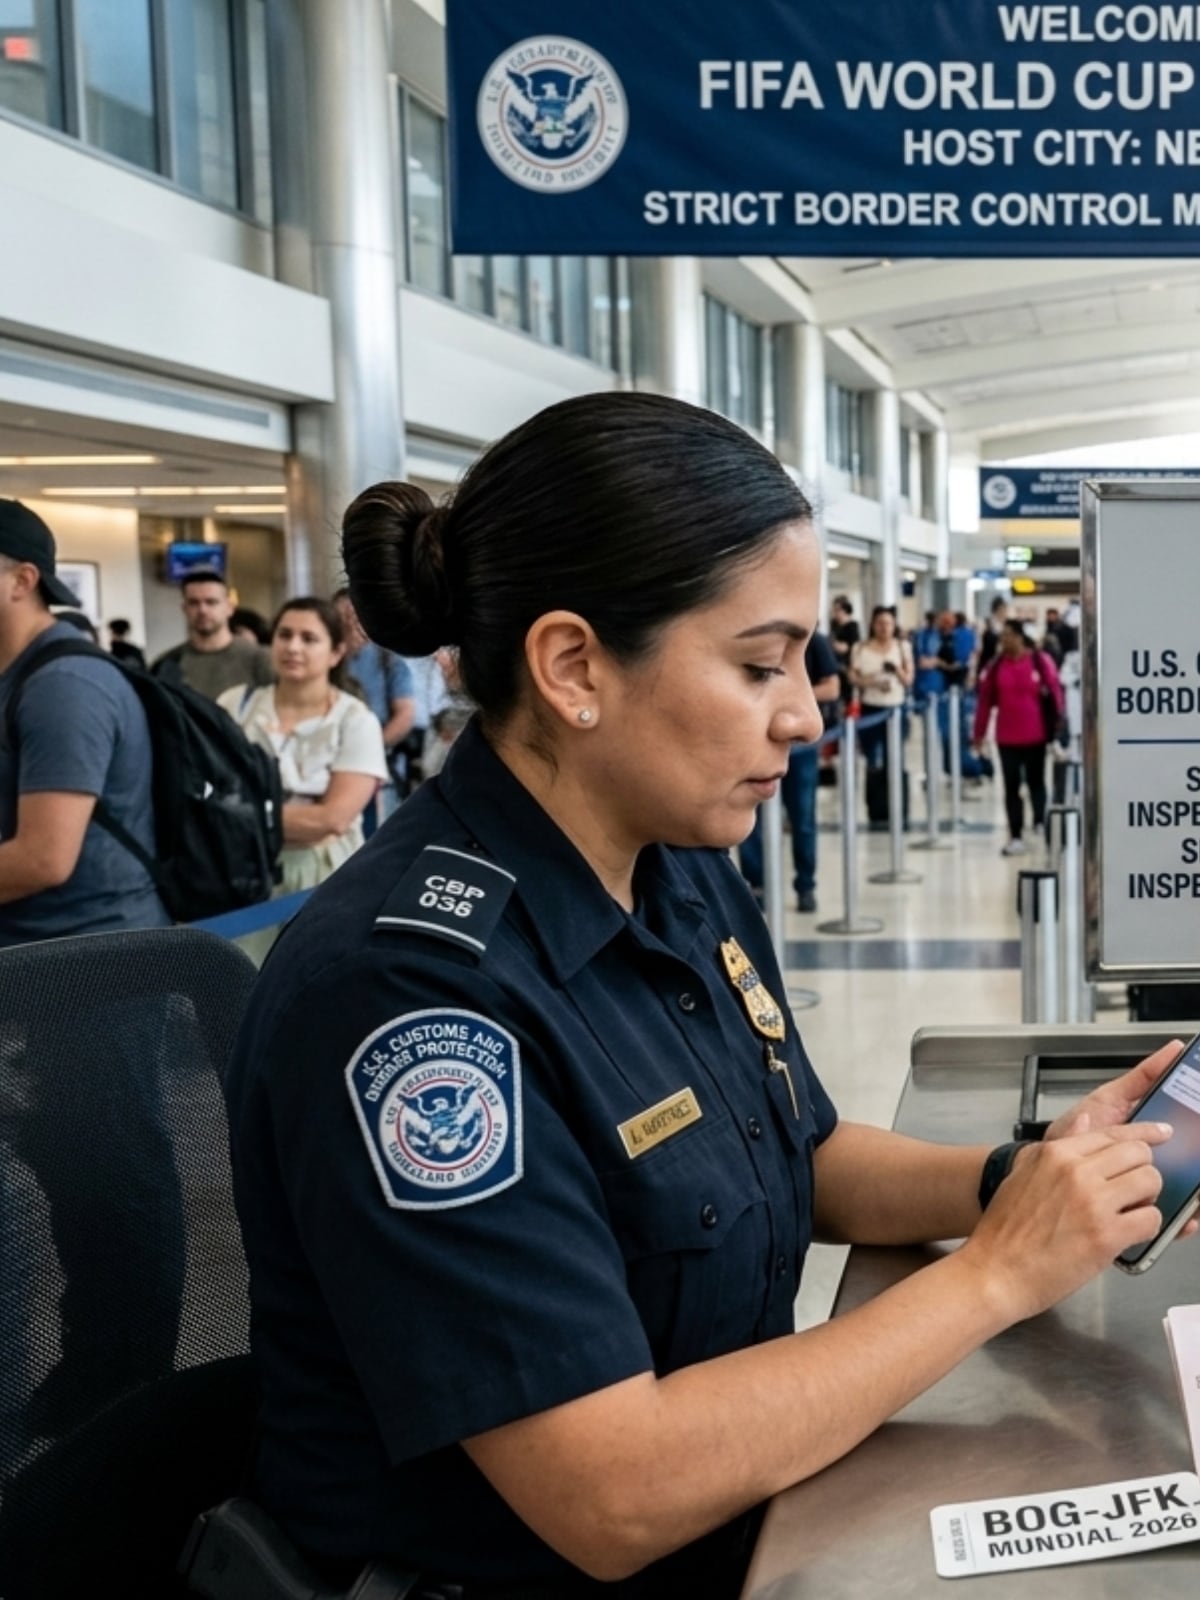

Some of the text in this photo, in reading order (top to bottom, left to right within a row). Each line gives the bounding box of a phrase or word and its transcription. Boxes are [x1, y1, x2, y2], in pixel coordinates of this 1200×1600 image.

[701, 62, 823, 108] FIFA
[837, 62, 1055, 109] WORLD
[1074, 62, 1194, 110] CUP
[905, 130, 1021, 165] HOST
[1035, 130, 1140, 165] CITY:
[645, 192, 782, 224] STRICT
[796, 193, 960, 225] BORDER
[972, 193, 1161, 225] CONTROL
[1132, 650, 1186, 677] U.S.
[424, 875, 485, 898] CBP
[988, 1527, 1122, 1559] MUNDIAL
[1129, 1512, 1198, 1539] 2026
